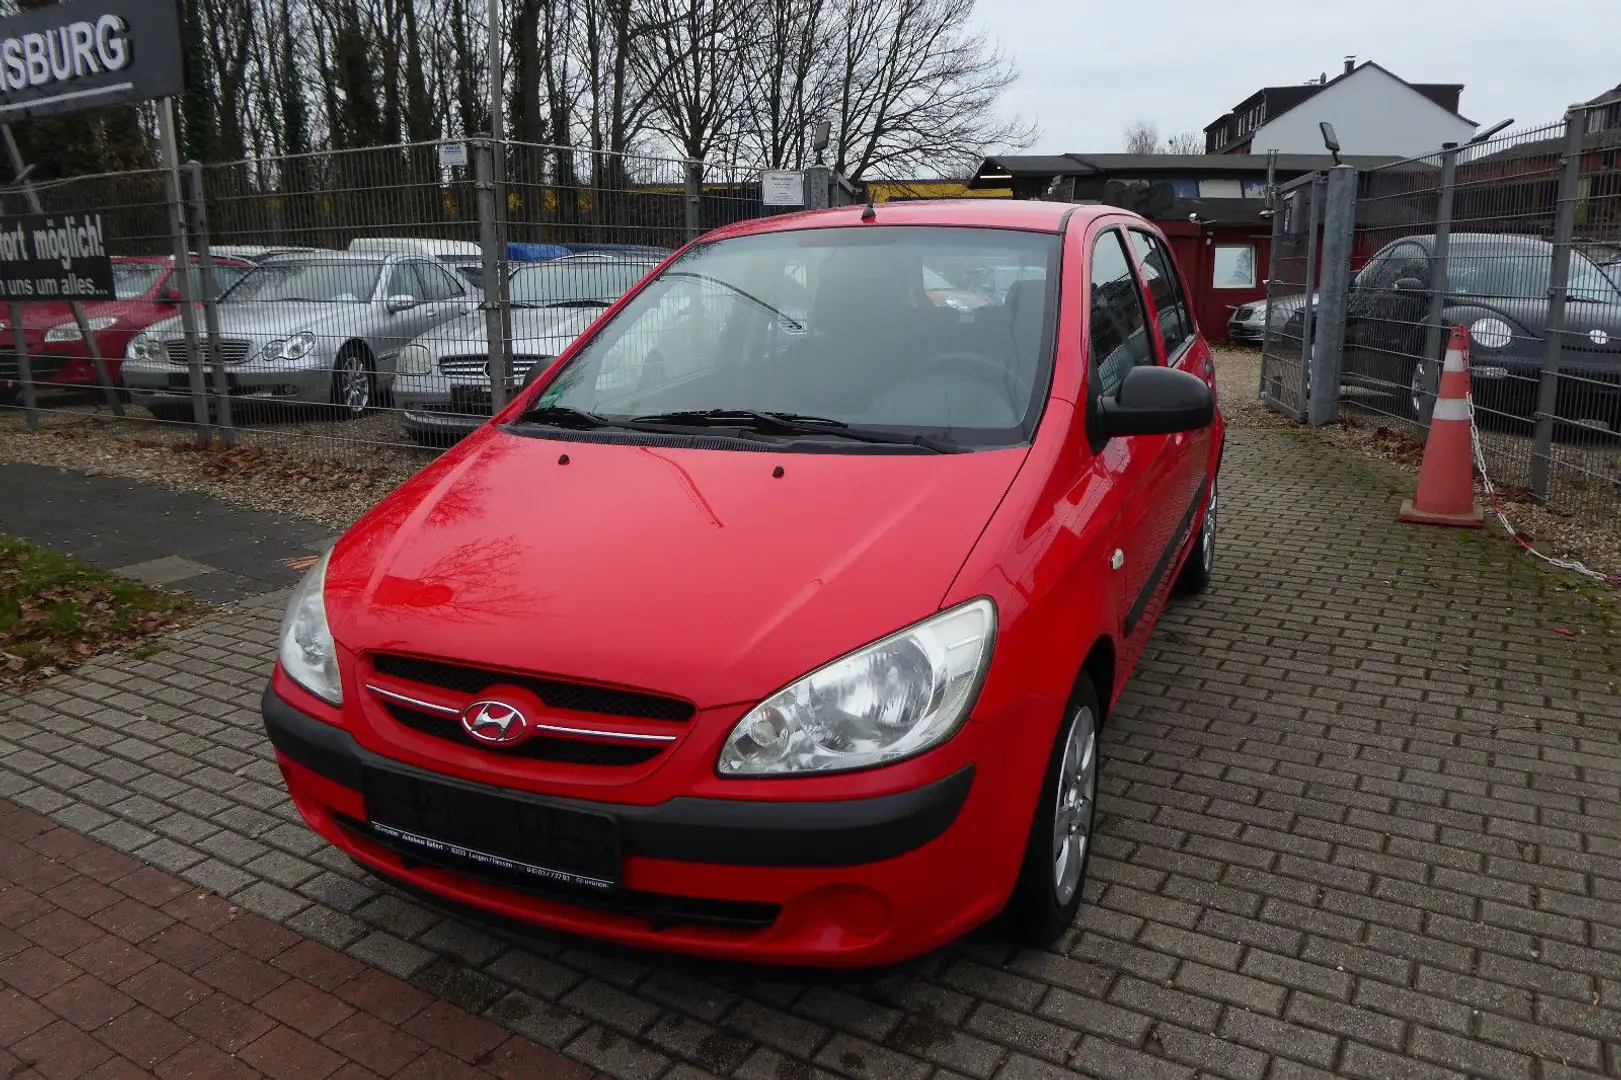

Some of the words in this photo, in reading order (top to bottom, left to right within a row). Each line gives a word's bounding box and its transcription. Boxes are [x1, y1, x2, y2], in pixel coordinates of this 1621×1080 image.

[33, 213, 105, 270] möglich!
[7, 278, 33, 295] uns
[36, 278, 59, 295] um
